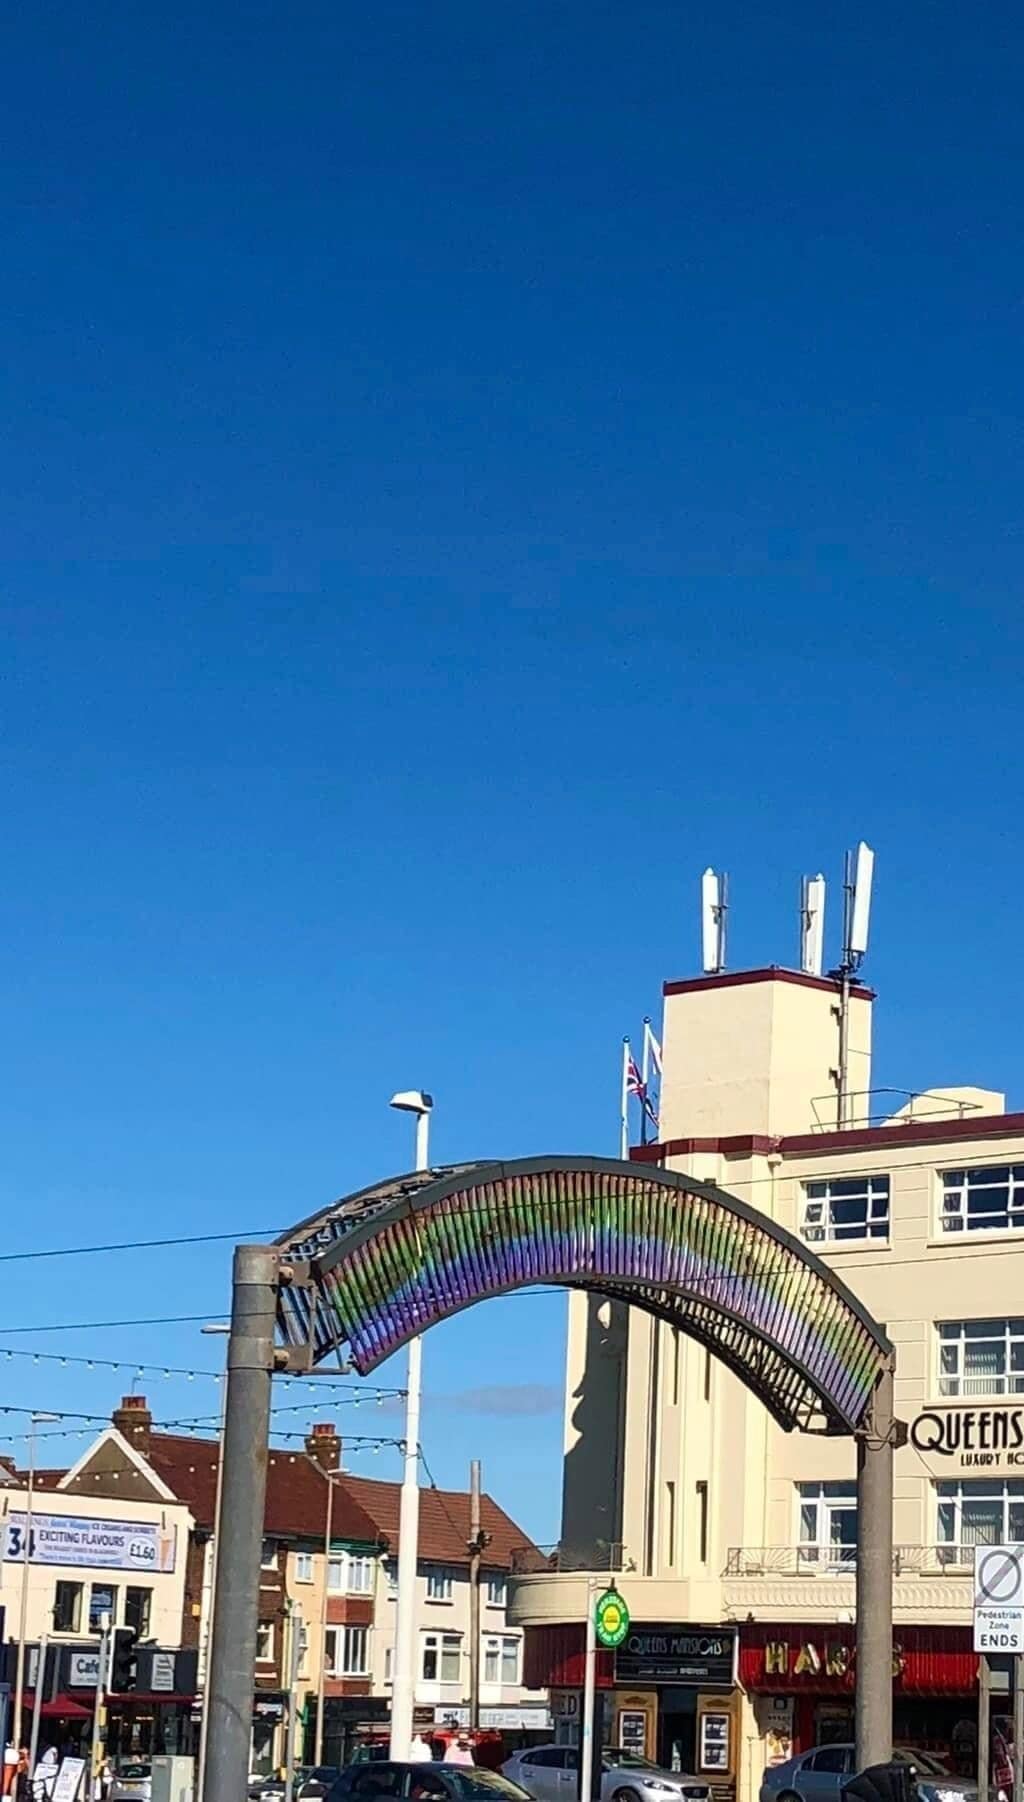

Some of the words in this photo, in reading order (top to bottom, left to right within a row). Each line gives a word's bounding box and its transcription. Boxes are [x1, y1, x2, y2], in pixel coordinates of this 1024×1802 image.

[910, 1411, 1024, 1455] QUEENS
[960, 1453, 1001, 1467] LUXURY
[39, 1530, 80, 1543] EXCITING
[81, 1533, 125, 1547] FLAVOURS
[977, 1610, 1022, 1619] Pedestrian
[989, 1621, 1009, 1630] Zone
[980, 1634, 1018, 1647] ENDS
